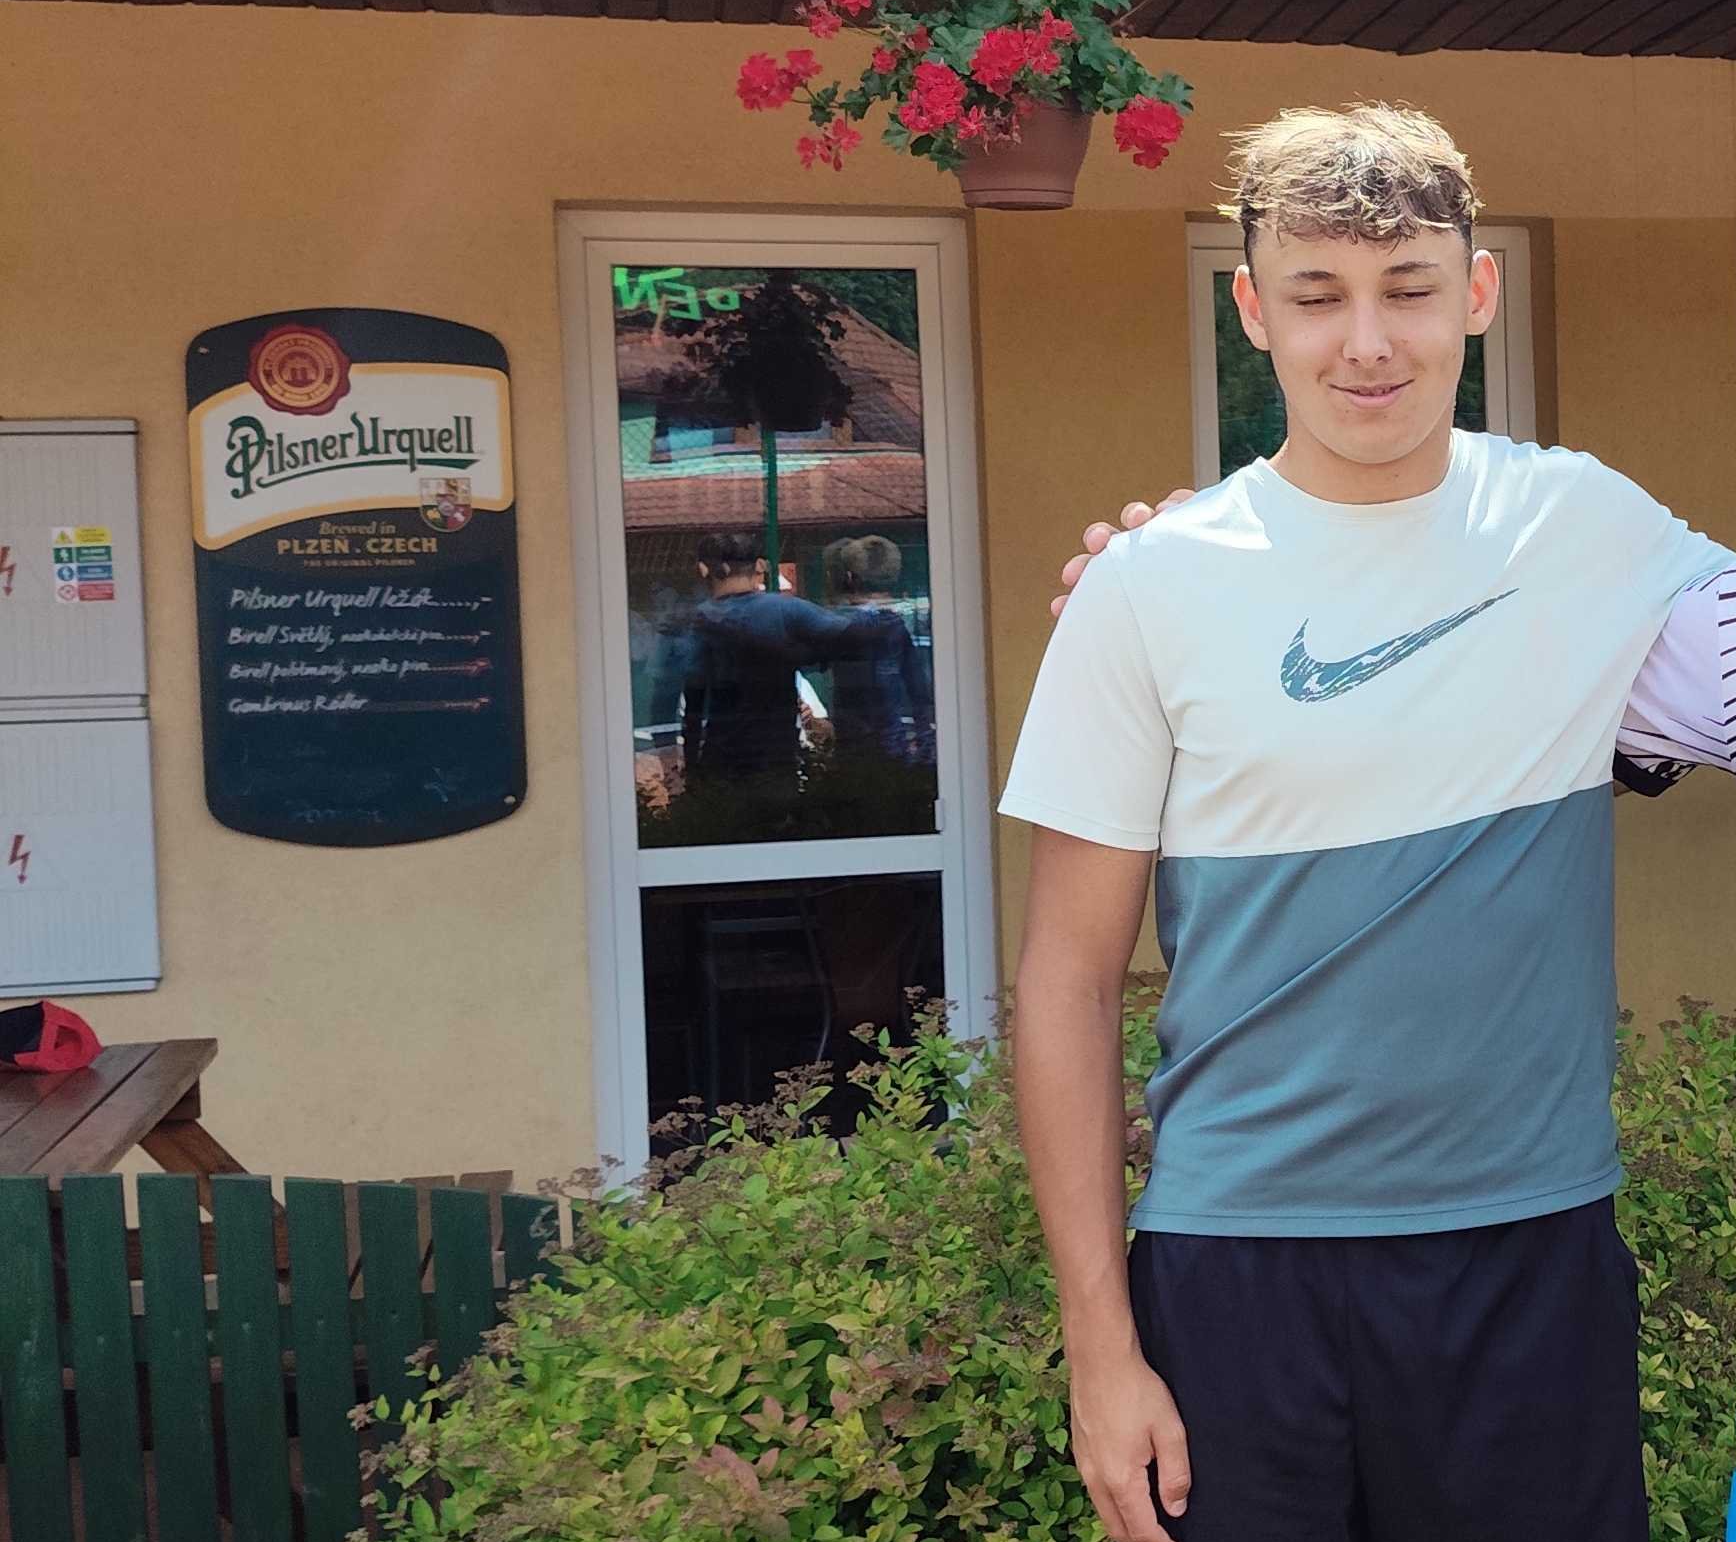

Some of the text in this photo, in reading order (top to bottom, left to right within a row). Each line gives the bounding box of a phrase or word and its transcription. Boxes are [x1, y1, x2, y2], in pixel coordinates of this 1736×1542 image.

[225, 411, 475, 499] Pilsner Urquell
[319, 520, 396, 535] Brewed in
[366, 537, 438, 553] CZECH
[230, 586, 301, 609] Pilsner
[304, 586, 379, 617] Urquell
